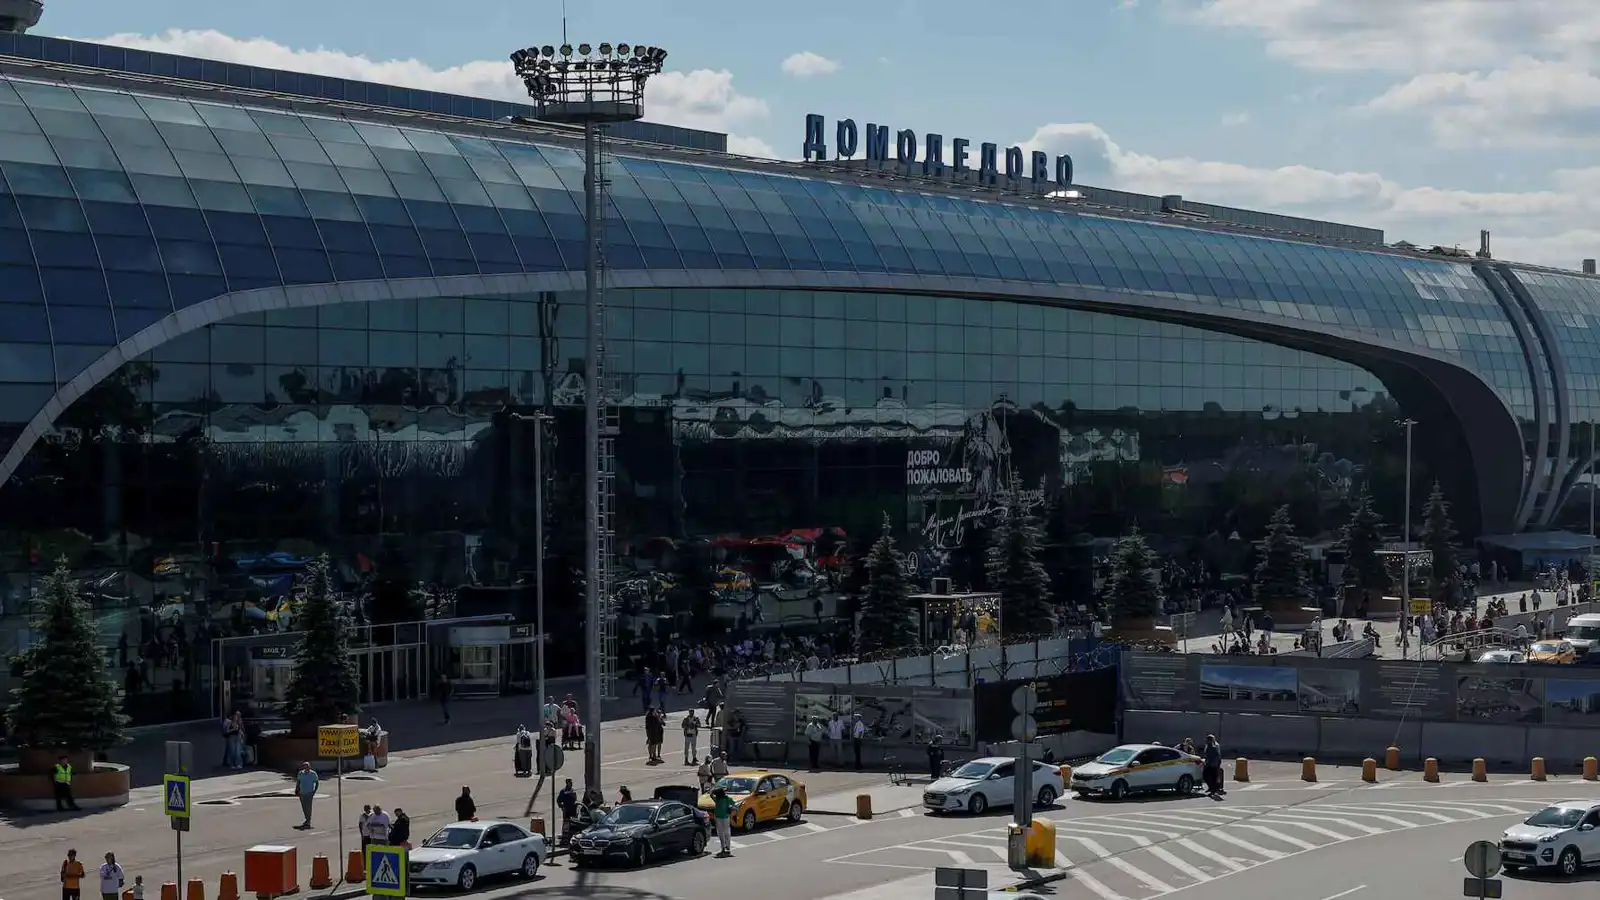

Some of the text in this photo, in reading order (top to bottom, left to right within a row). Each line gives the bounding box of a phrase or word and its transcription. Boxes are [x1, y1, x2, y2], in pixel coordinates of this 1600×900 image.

[803, 113, 1074, 188] ДОМОДЕДОВО
[906, 450, 940, 469] ДОБРО
[906, 467, 972, 485] ПОЖАЛОВАТЬ
[280, 647, 287, 658] 2
